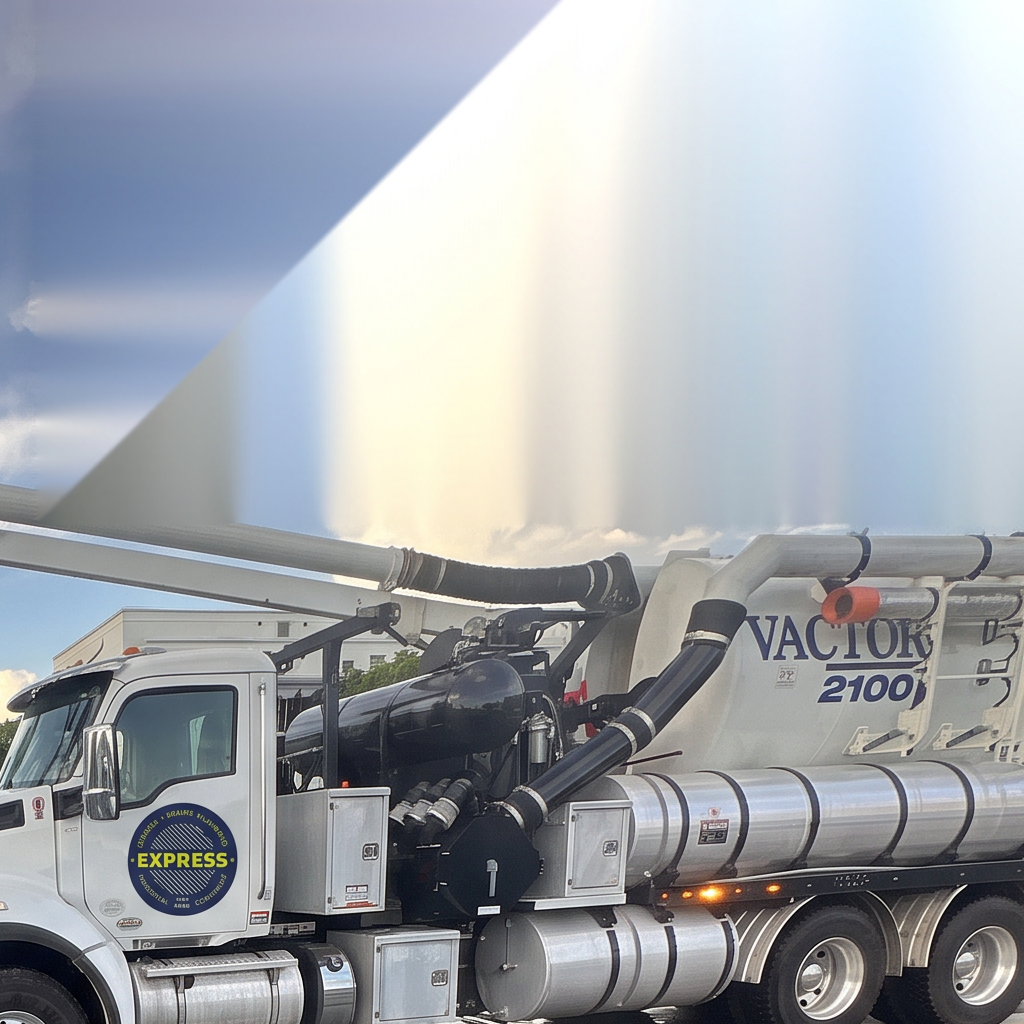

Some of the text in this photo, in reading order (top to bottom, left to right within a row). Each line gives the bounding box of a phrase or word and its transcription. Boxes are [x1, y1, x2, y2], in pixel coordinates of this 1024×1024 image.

[745, 615, 929, 661] VACTOR
[817, 674, 914, 704] 2100
[137, 852, 228, 868] EXPRESS
